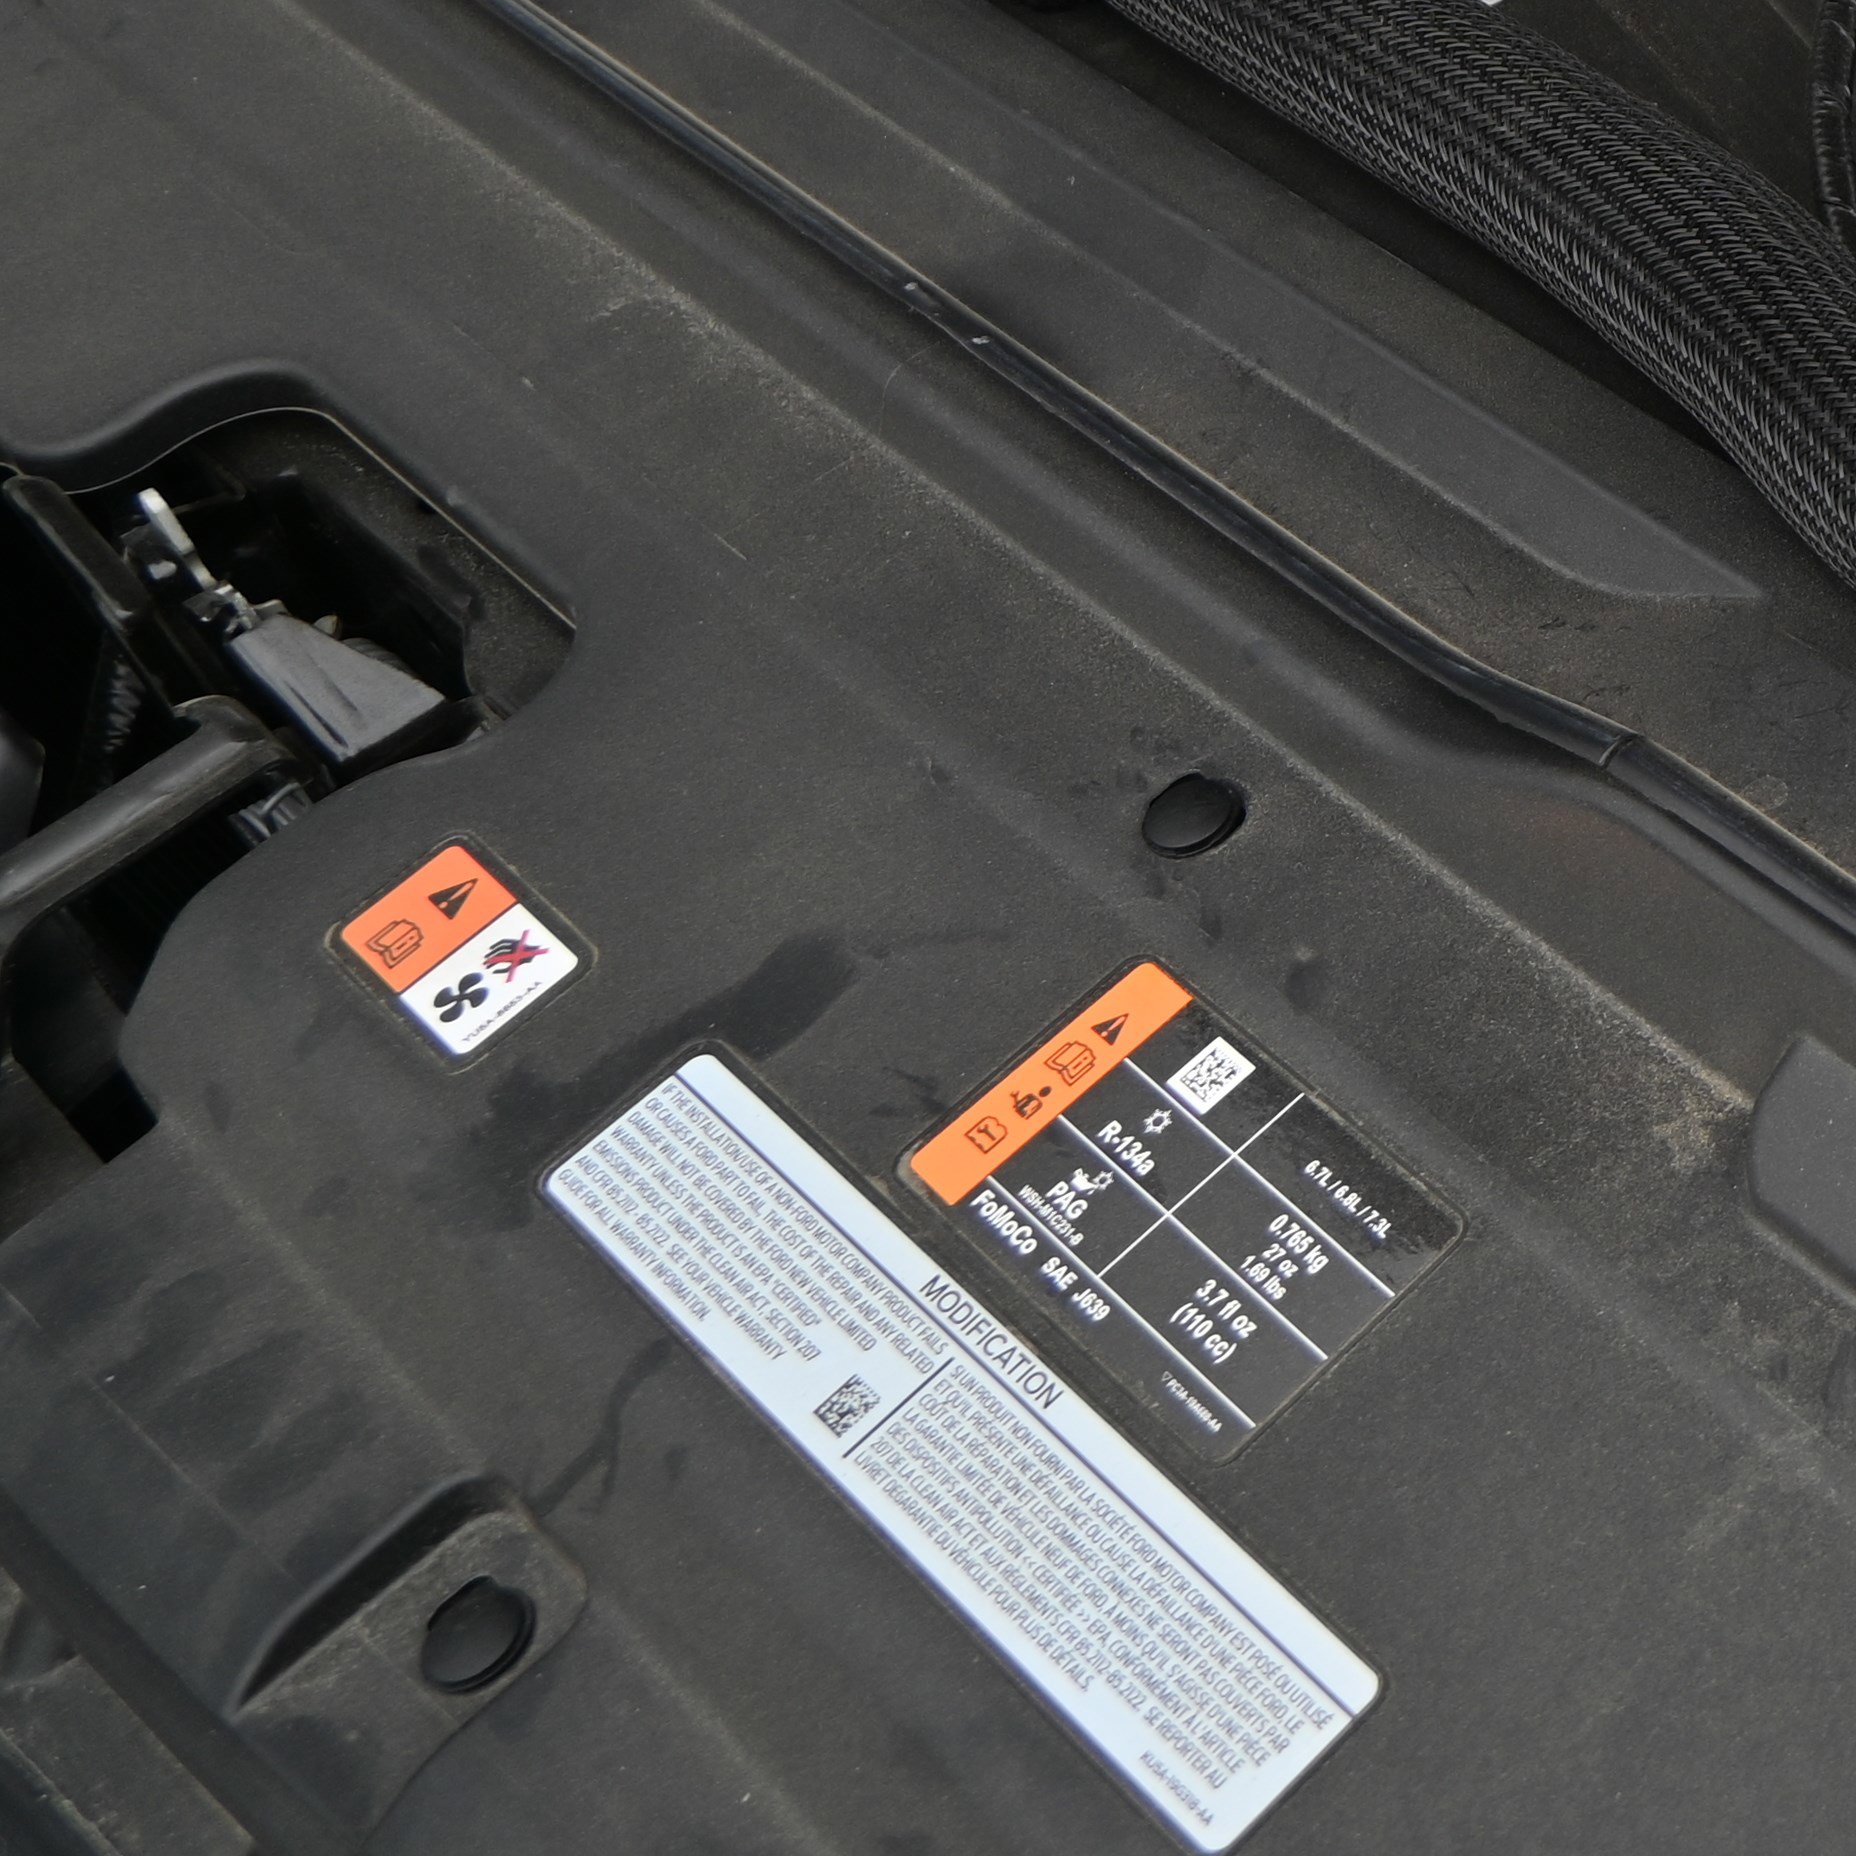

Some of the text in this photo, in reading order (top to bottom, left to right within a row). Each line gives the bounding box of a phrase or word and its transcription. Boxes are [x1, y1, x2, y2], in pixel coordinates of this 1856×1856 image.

[1095, 1118, 1161, 1177] R-134a
[659, 1081, 949, 1356] IF THE INSTALLATION/USE OF A NON-FORD MOTOR COMPANY PRODUCT FAILS
[1042, 1179, 1090, 1221] PAG
[1302, 1157, 1337, 1188] 6.7L
[1331, 1183, 1366, 1213] 6.8L
[1360, 1209, 1396, 1240] 7.3L
[968, 1188, 1113, 1323] FoMoCo SAE J639
[1237, 1253, 1290, 1301] 1.69 lbs
[1260, 1242, 1299, 1279] 27 oz
[1265, 1211, 1334, 1277] 0.765 kg
[917, 1272, 1066, 1410] MODIFICATION
[1167, 1300, 1239, 1366] (110 cc)
[1193, 1277, 1259, 1340] 3.7 fl oz
